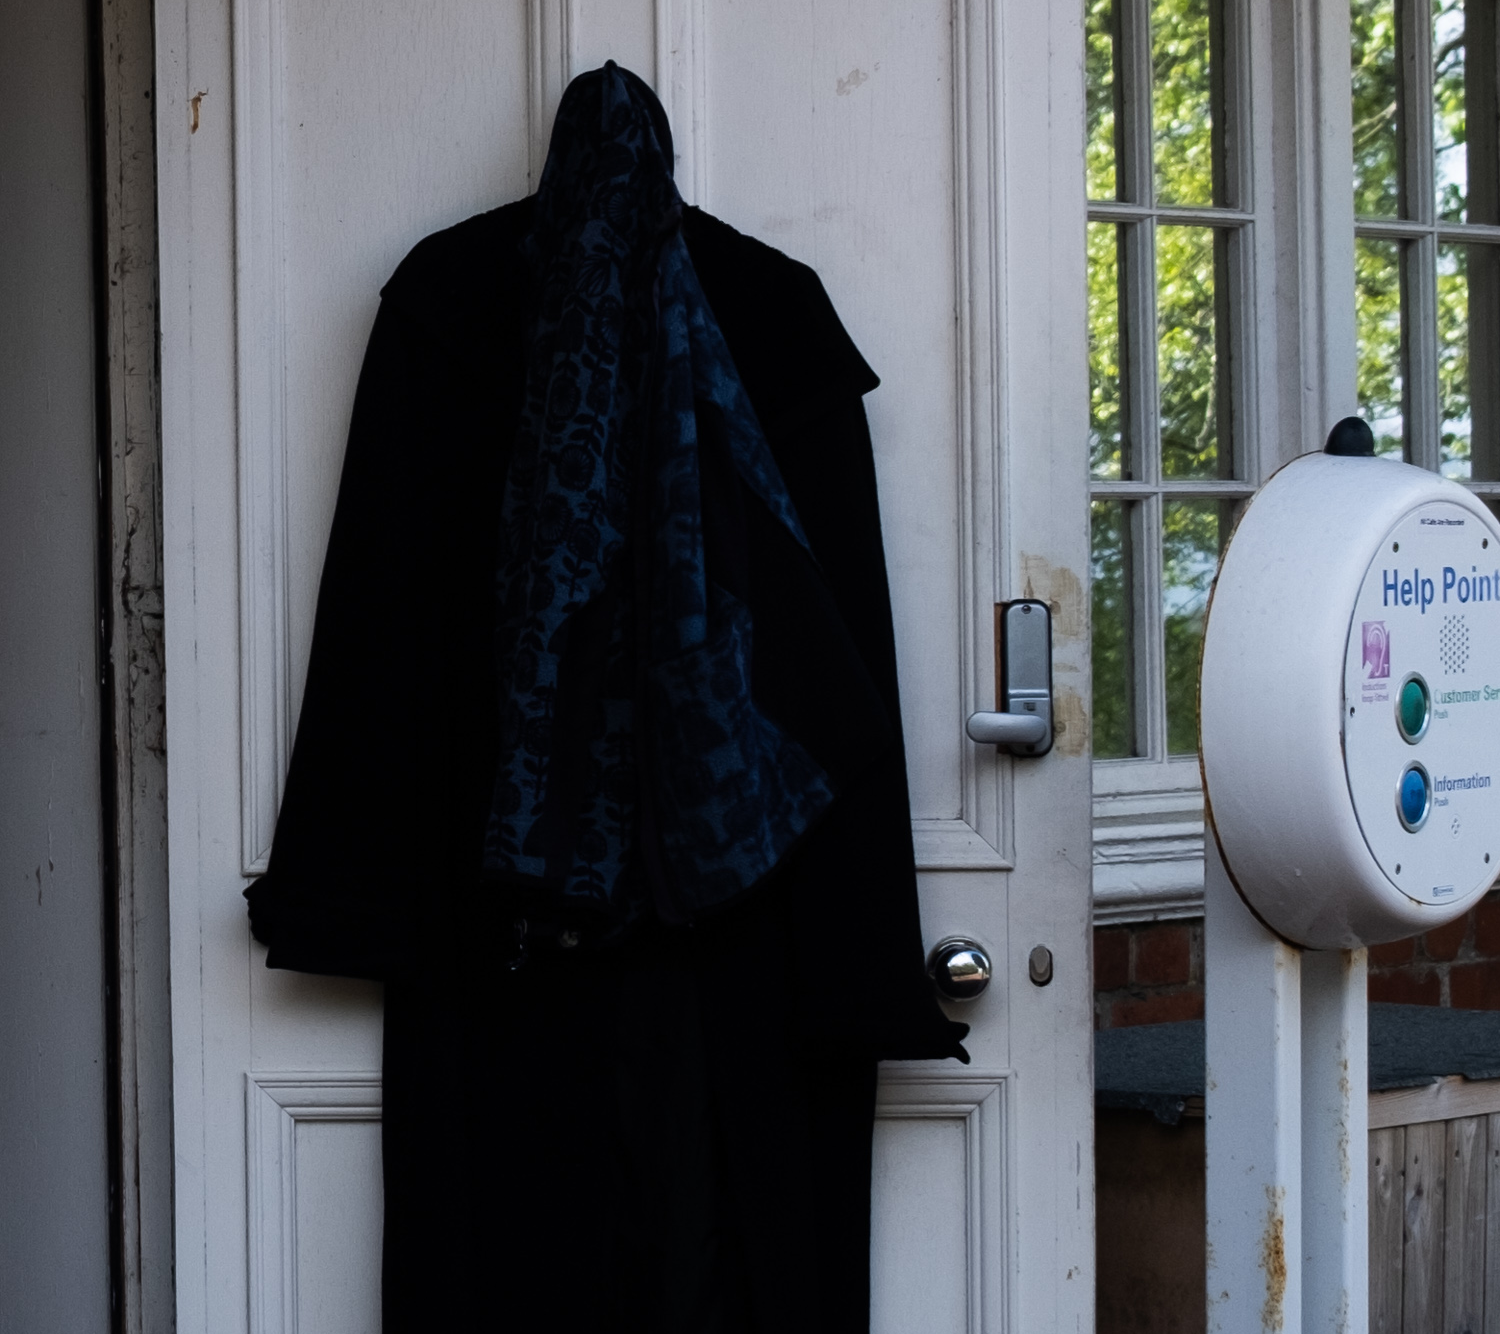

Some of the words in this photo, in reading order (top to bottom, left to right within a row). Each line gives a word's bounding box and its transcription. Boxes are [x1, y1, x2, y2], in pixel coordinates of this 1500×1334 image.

[1383, 568, 1434, 614] Help
[1443, 566, 1500, 603] Point
[1434, 688, 1480, 704] Customer
[1434, 773, 1490, 792] Information
[1434, 797, 1448, 806] Push
